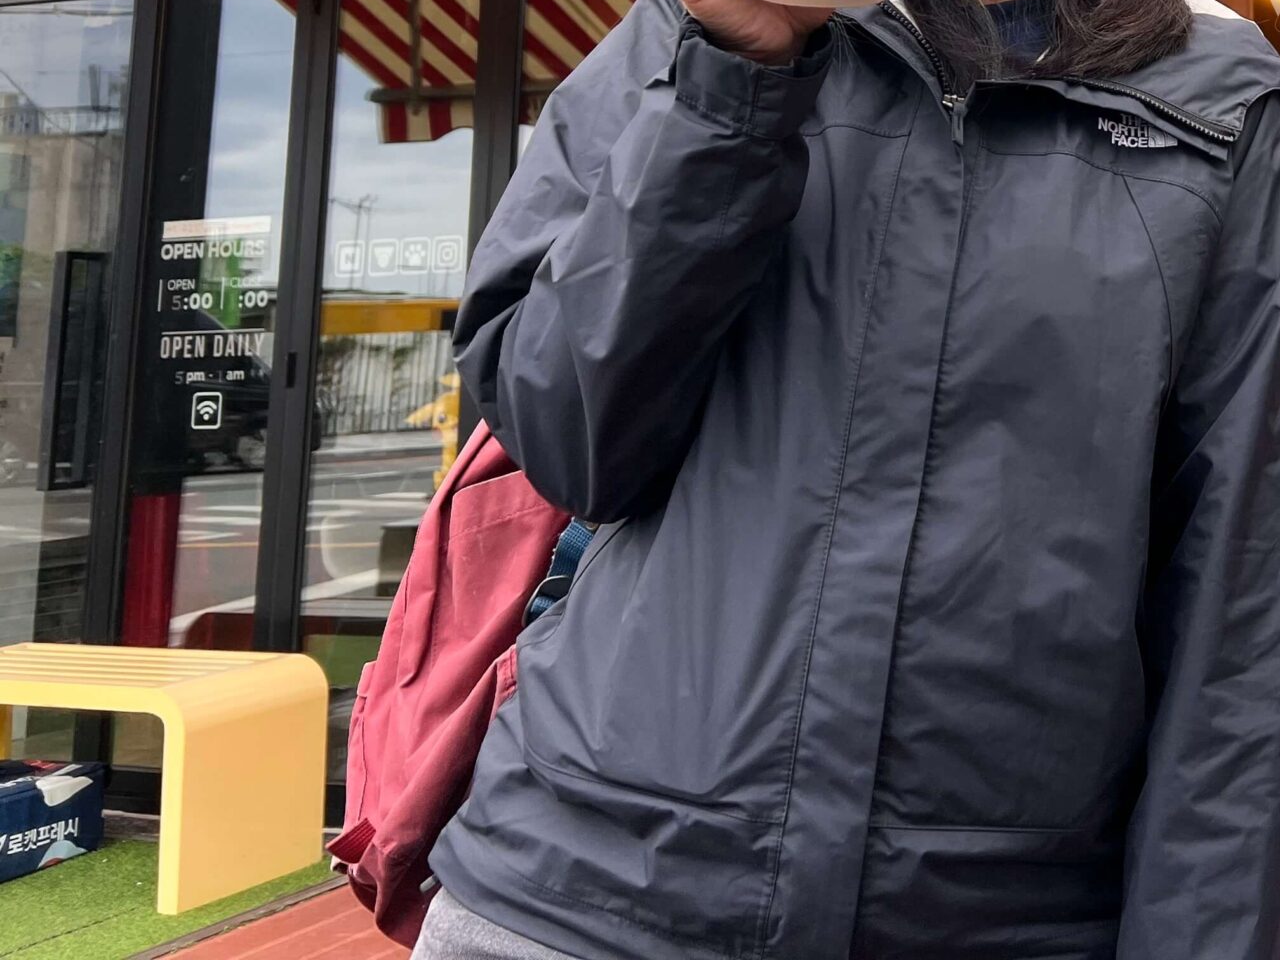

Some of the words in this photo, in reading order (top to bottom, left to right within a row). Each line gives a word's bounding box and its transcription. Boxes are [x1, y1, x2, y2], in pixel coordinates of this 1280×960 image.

[1097, 117, 1149, 137] NORTH
[1111, 133, 1149, 148] FACE
[161, 243, 204, 260] OPEN
[207, 239, 265, 258] HOURS
[167, 279, 196, 291] OPEN
[171, 293, 213, 310] 5:00
[160, 335, 206, 359] OPEN
[213, 332, 265, 357] DAILY
[226, 370, 245, 381] am
[7, 817, 79, 855] 로켓프레시
